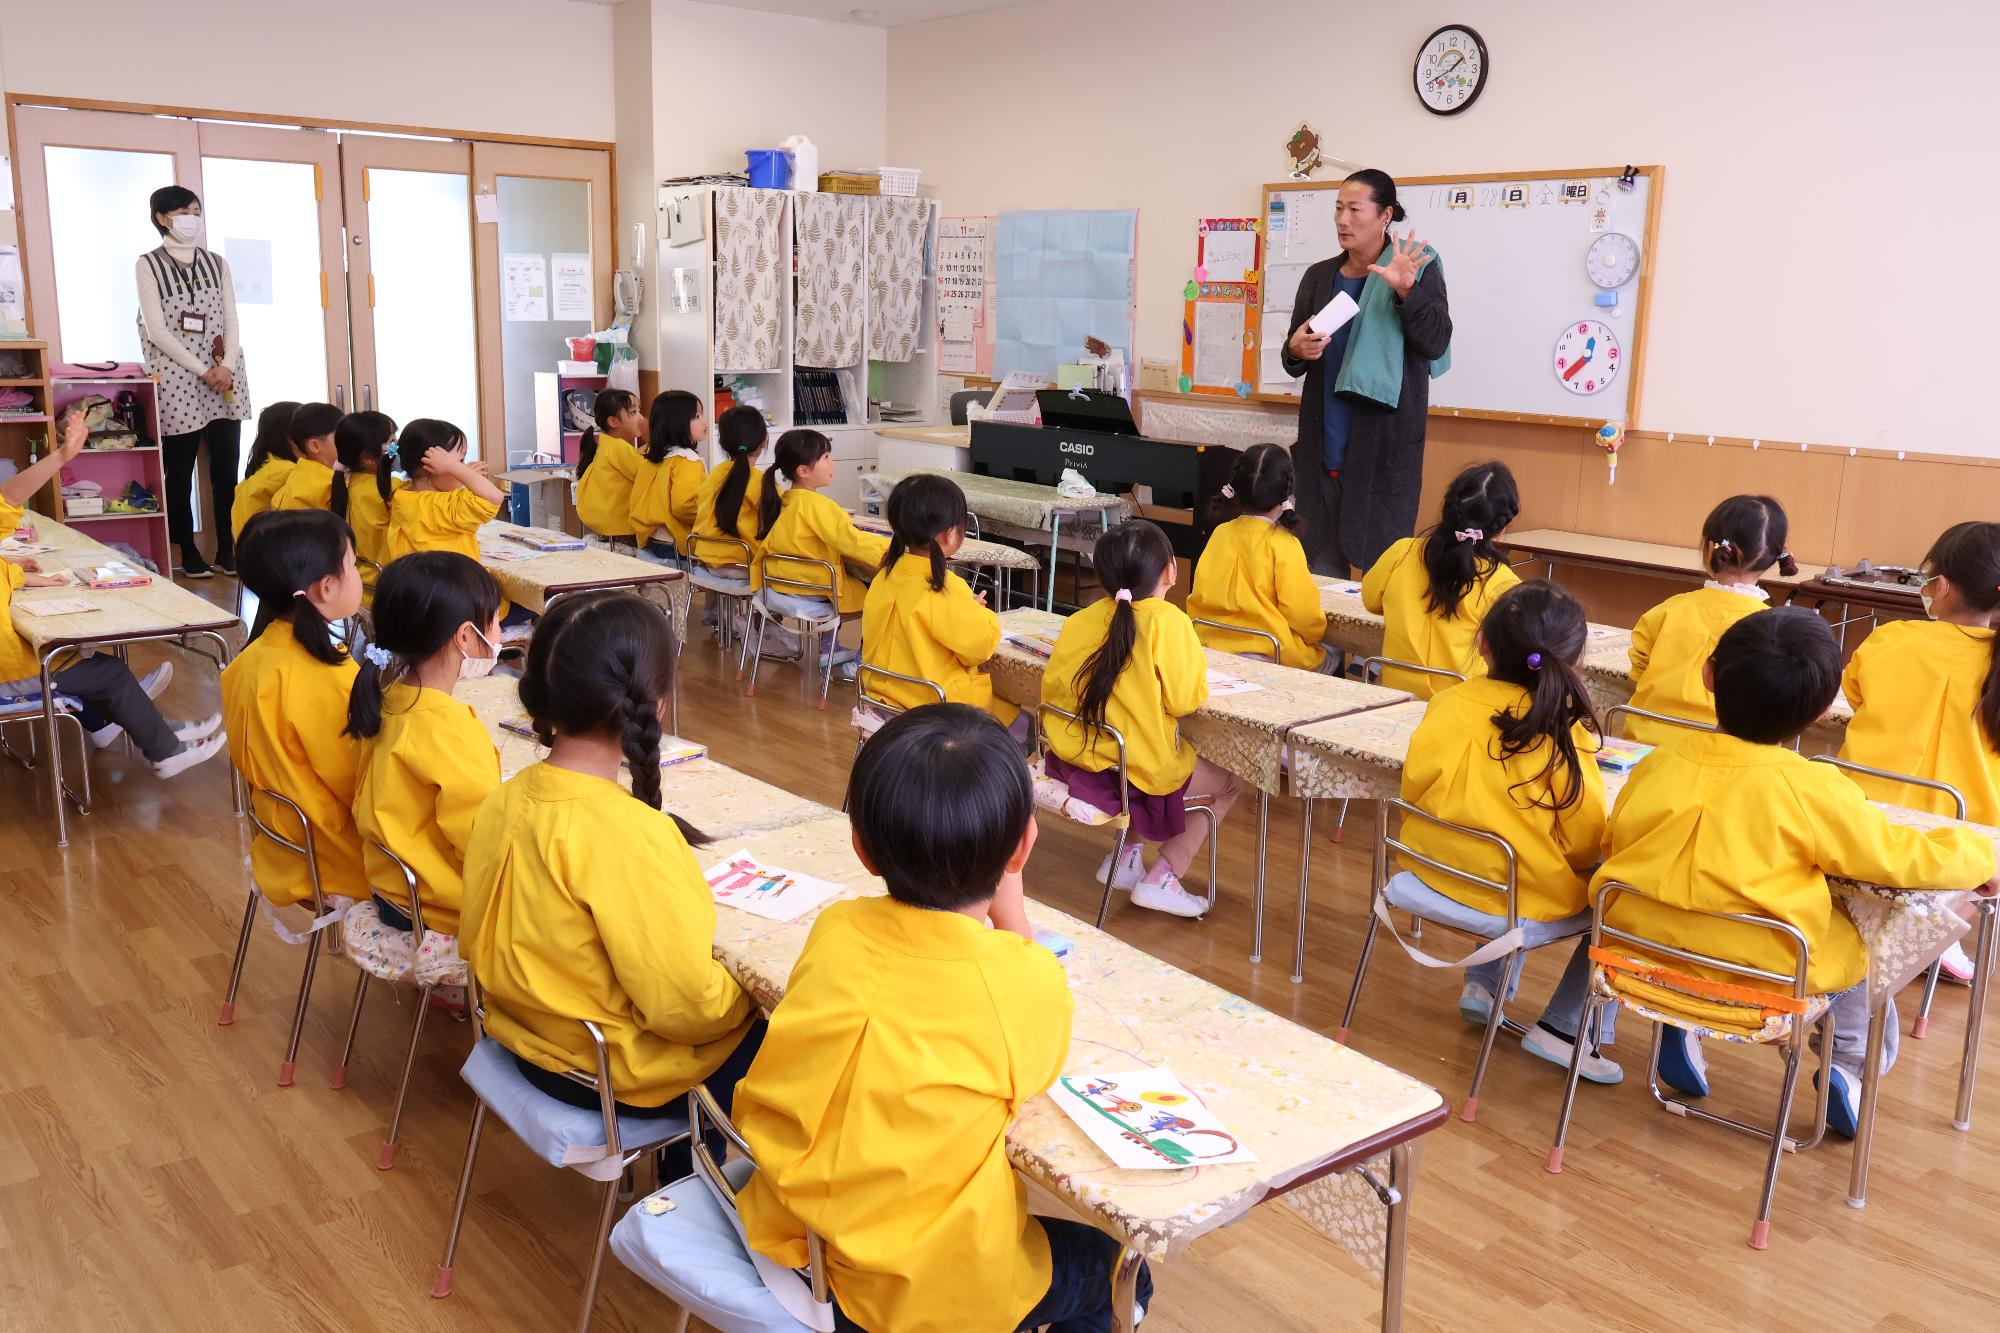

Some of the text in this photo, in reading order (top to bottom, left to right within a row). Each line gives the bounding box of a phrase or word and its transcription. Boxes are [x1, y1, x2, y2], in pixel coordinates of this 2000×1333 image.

[1449, 36, 1458, 47] 12
[1438, 42, 1445, 52] 11
[1428, 54, 1438, 64] 10
[1469, 49, 1475, 59] 2
[1426, 68, 1432, 78] 9
[1471, 64, 1478, 74] 3
[1428, 82, 1434, 92] 8
[1466, 79, 1473, 88] 4
[1436, 92, 1442, 101] 7
[1446, 94, 1452, 104] 6
[1458, 90, 1464, 100] 5
[1454, 192, 1468, 204] 月
[1480, 188, 1498, 208] 28
[1509, 190, 1522, 202] 日
[1536, 184, 1554, 206] 金
[1566, 185, 1587, 198] 曜日
[961, 226, 966, 235] 11
[1580, 324, 1588, 334] 12
[1611, 348, 1618, 359] 3
[1558, 358, 1564, 368] 9
[1609, 364, 1615, 372] 4
[1587, 380, 1594, 390] 6
[1060, 442, 1094, 456] CASIO
